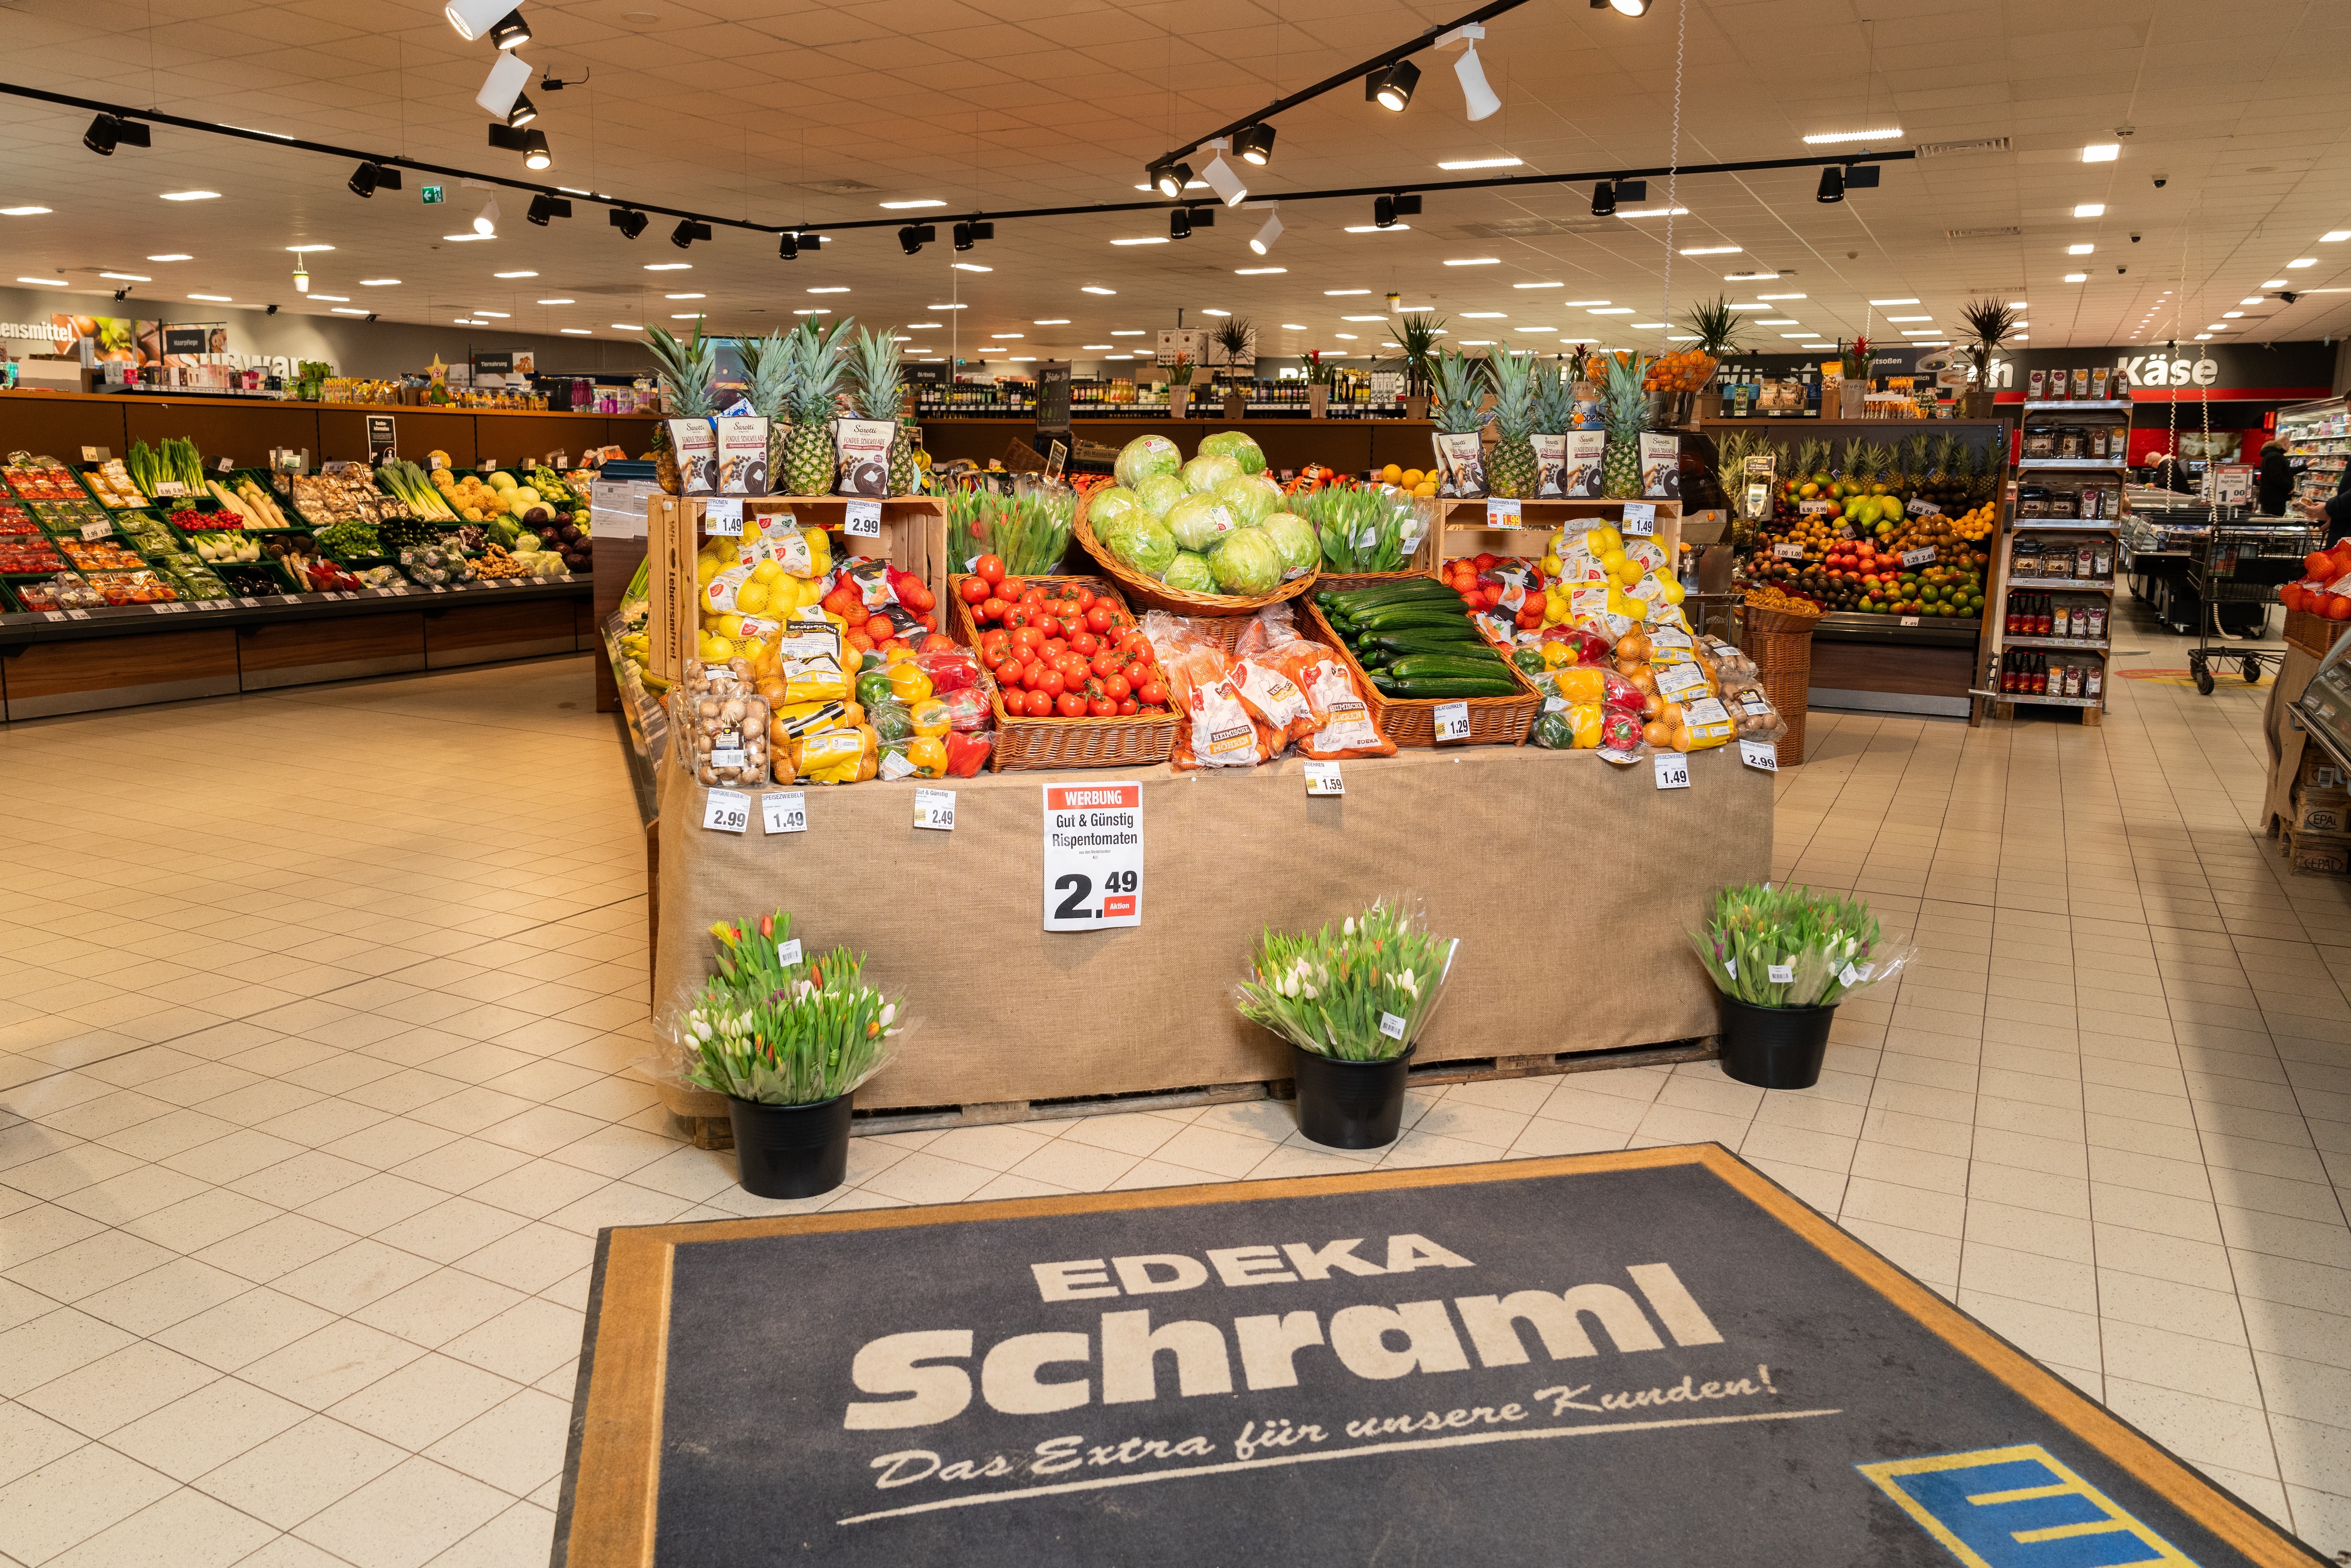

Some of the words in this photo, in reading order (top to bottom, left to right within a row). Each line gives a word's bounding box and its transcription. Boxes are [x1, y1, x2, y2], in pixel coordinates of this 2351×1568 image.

[0, 321, 77, 342] ensmittel.
[2117, 354, 2218, 387] Käse
[686, 423, 705, 431] Sarotti
[734, 422, 755, 431] Sarotti
[854, 425, 877, 433] Sarotti
[1545, 437, 1559, 445] Sarotti
[723, 518, 742, 531] 1.49
[852, 518, 878, 533] 2.99
[1503, 514, 1520, 526] 1.99
[1637, 520, 1652, 532] 1.49
[790, 624, 836, 633] erdperlen
[1329, 703, 1364, 711] HEIMISCHE
[1434, 703, 1462, 711] SALATGURKEN
[1450, 719, 1468, 734] 1.29
[1213, 726, 1250, 741] HEIMISCHE
[1212, 736, 1249, 753] MÖHREN
[1749, 755, 1775, 768] 2.99
[1663, 770, 1687, 783] 1.49
[1323, 779, 1342, 790] 1.59
[709, 788, 730, 797] CHAMPIGNONS
[762, 792, 804, 801] SPEISEZWIEBELN
[1065, 790, 1122, 806] WERBUNG
[714, 810, 746, 827] 2.99
[773, 812, 804, 827] 1.49
[932, 809, 953, 825] 2.49
[1057, 814, 1075, 828] Gut
[1079, 814, 1087, 827] &
[1091, 812, 1134, 828] Günstig
[2313, 814, 2338, 826] EPAL
[1052, 832, 1137, 849] Rispentomaten
[2311, 858, 2336, 870] EPAL
[1031, 1234, 1474, 1302] EDEKA
[844, 1263, 1724, 1430] Schraml
[870, 1450, 1013, 1488] Das
[1030, 1436, 1215, 1474] Extra
[1235, 1421, 1327, 1460] für
[1346, 1403, 1528, 1437] unsere
[1534, 1364, 1770, 1416] Kunden!
